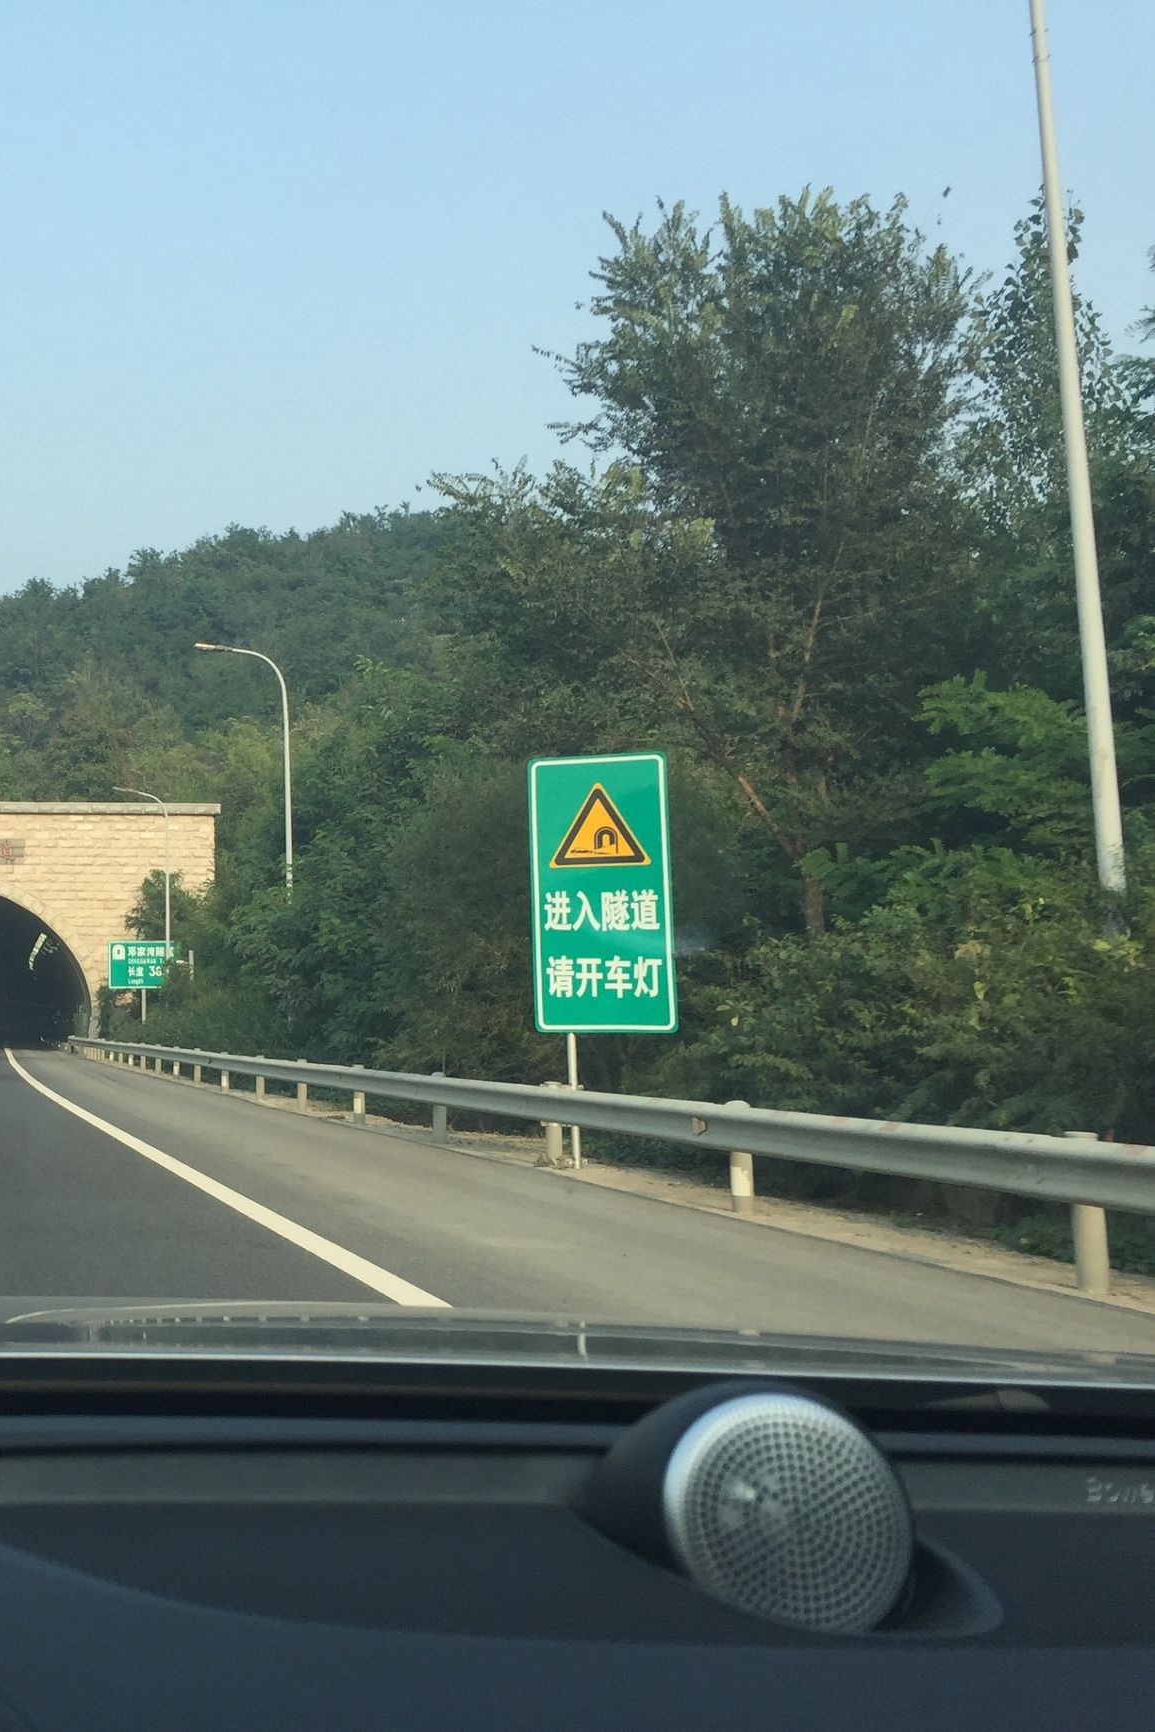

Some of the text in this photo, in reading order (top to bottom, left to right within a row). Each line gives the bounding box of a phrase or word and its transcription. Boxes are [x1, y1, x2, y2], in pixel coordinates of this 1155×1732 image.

[544, 889, 660, 931] 进入隧道
[127, 966, 144, 977] 长度
[546, 955, 662, 998] 请开车灯
